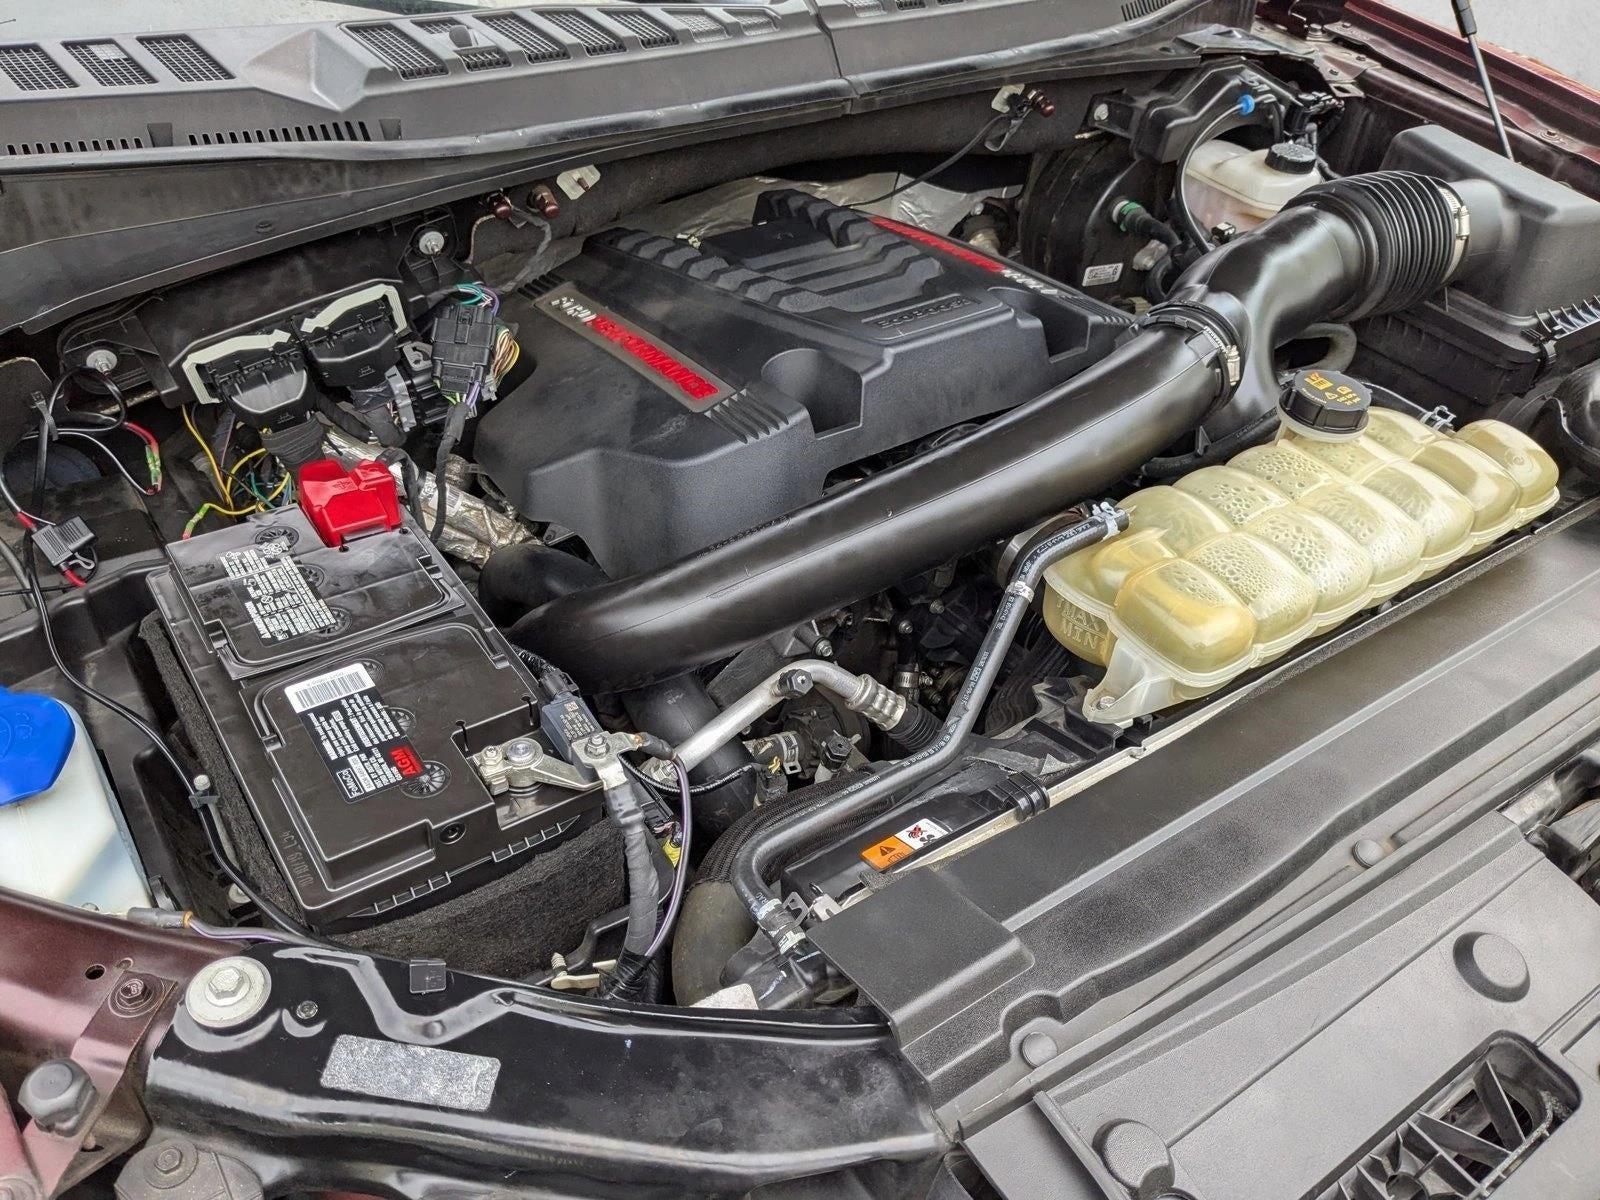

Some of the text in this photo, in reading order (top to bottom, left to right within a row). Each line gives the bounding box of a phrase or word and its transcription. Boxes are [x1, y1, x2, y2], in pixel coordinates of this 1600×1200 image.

[1062, 601, 1100, 631] MAX
[1061, 617, 1099, 649] MIN
[390, 747, 416, 776] AGM
[339, 769, 361, 796] FoMoCo
